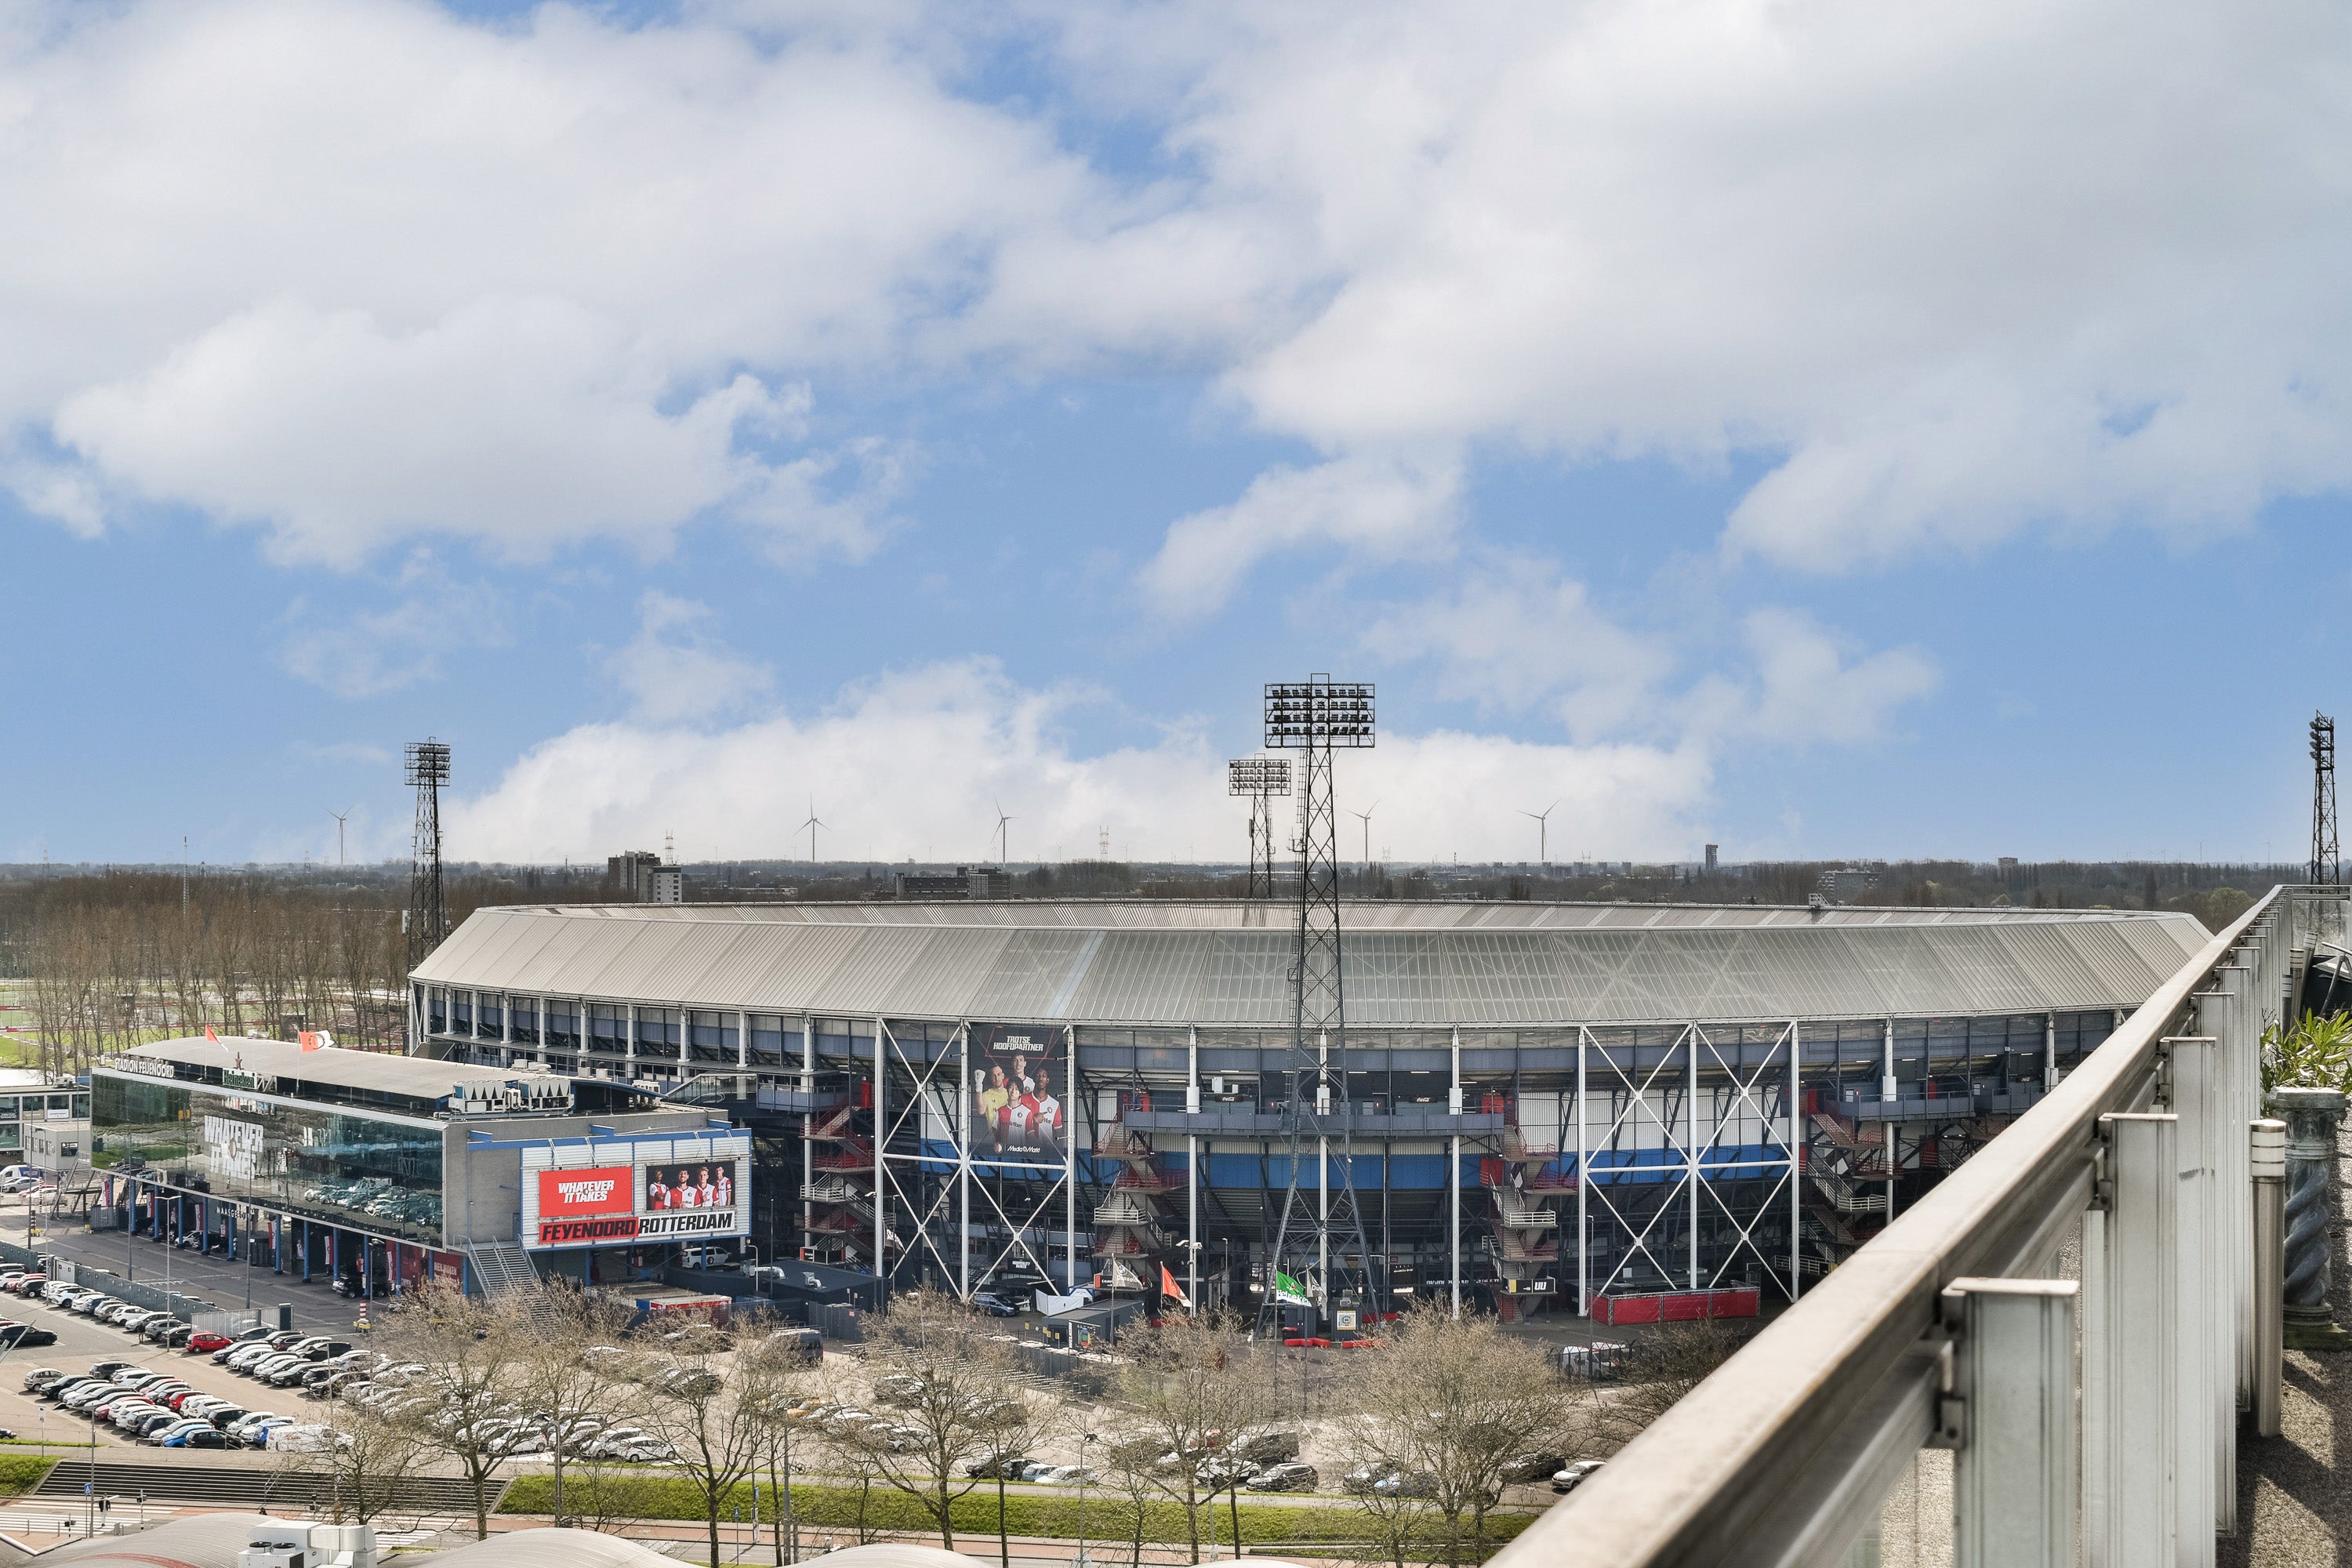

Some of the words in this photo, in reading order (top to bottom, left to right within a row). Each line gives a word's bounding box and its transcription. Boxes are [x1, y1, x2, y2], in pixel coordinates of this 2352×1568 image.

[993, 1042, 1044, 1051] HOOFDPARTNER
[114, 1058, 138, 1073] STADION
[224, 1069, 255, 1088] Heineken
[204, 1115, 264, 1152] WHATEVER
[558, 1180, 615, 1193] WHATEVER
[564, 1192, 576, 1203] IT
[575, 1190, 608, 1203] TAKES
[543, 1219, 636, 1241] FEYENOORD
[638, 1212, 733, 1234] ROTTERDAM
